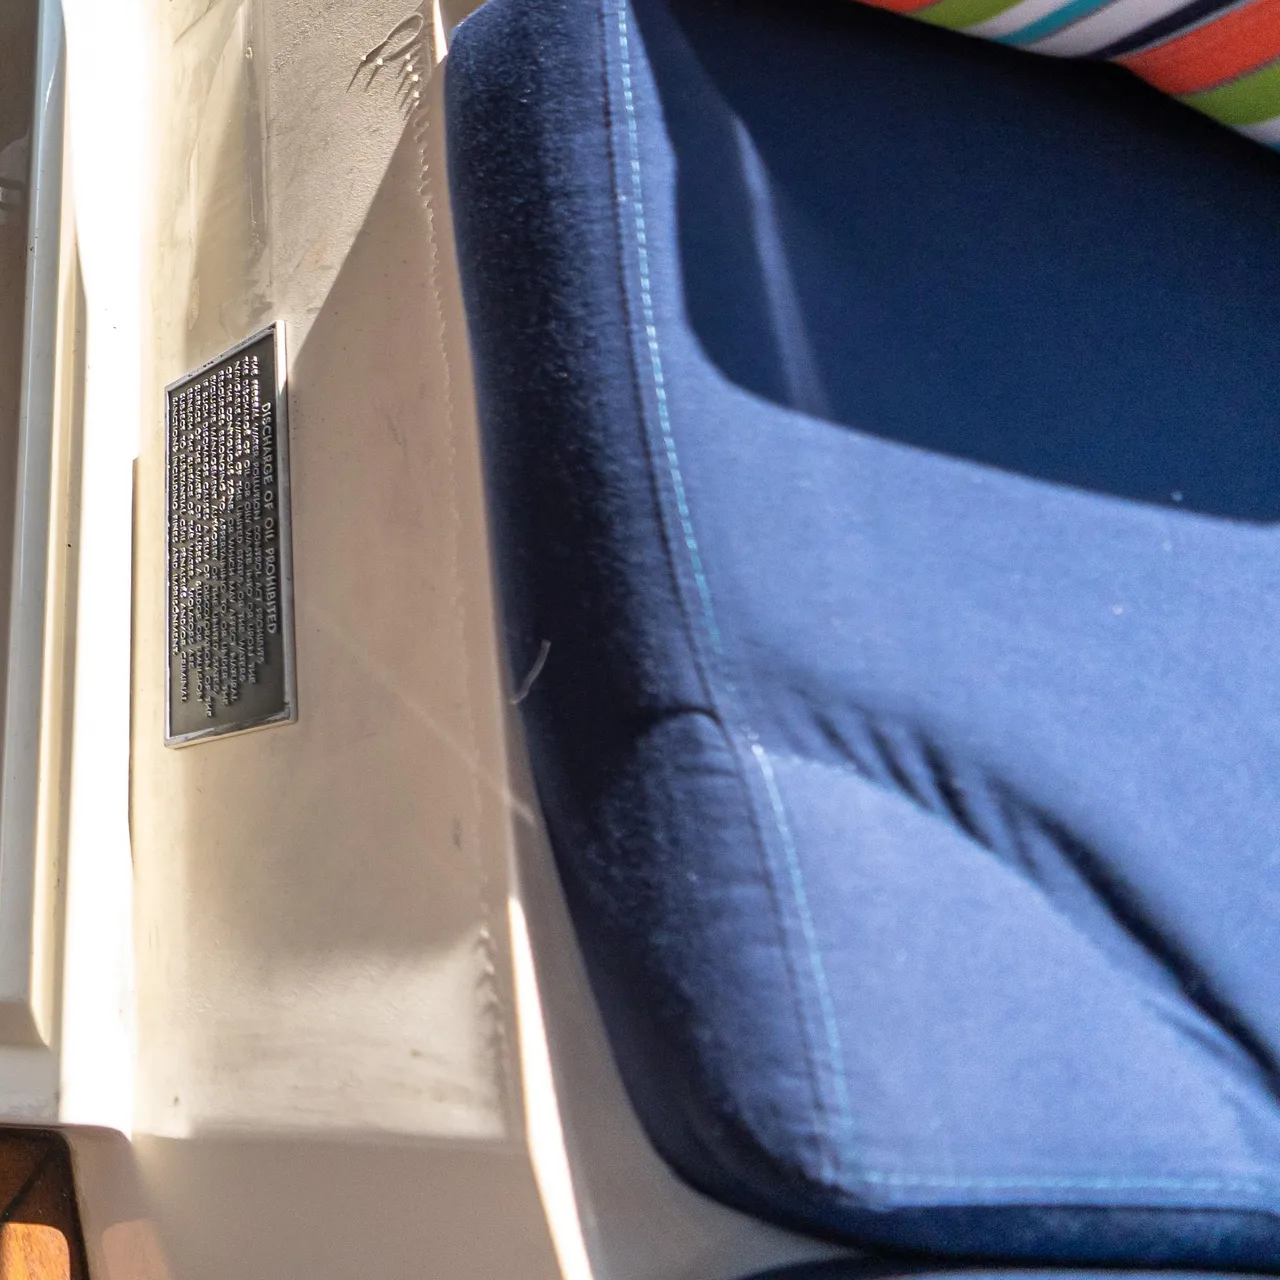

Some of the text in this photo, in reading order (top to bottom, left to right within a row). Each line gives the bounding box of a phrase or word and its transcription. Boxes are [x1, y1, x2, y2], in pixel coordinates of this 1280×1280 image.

[193, 384, 201, 425] SURFACE
[201, 391, 209, 419] SUCH
[186, 456, 194, 498] SURFACE
[201, 421, 209, 478] DISCHARGE
[178, 453, 186, 514] SUBSTANTIAL
[202, 481, 210, 521] CAUSES
[249, 355, 263, 602] THE FEDERAL WATER POLLUTION CONTROL ACT
[186, 520, 194, 540] THE
[209, 374, 219, 652] EXCLUSIVE MANAGEMENT AUTHORITY THE UNITED
[216, 370, 229, 708] RESOURCES BELONGING UNDER THE
[232, 360, 247, 683] NAVIGABLE WATERS THE UNITED THE WATERS
[241, 356, 256, 685] THE DISCHARGE OIL OILY WASTE INTO UPON THE
[260, 400, 278, 635] DISCHARGE OF OIL PROHIBITED
[194, 523, 202, 565] CAUSES
[225, 383, 238, 703] THE CONTIGUOUS WHICH MAY AFFECT NATURAL
[187, 587, 195, 645] VIOLATORS
[179, 651, 187, 703] CRIMINAL
[204, 698, 212, 718] THE
